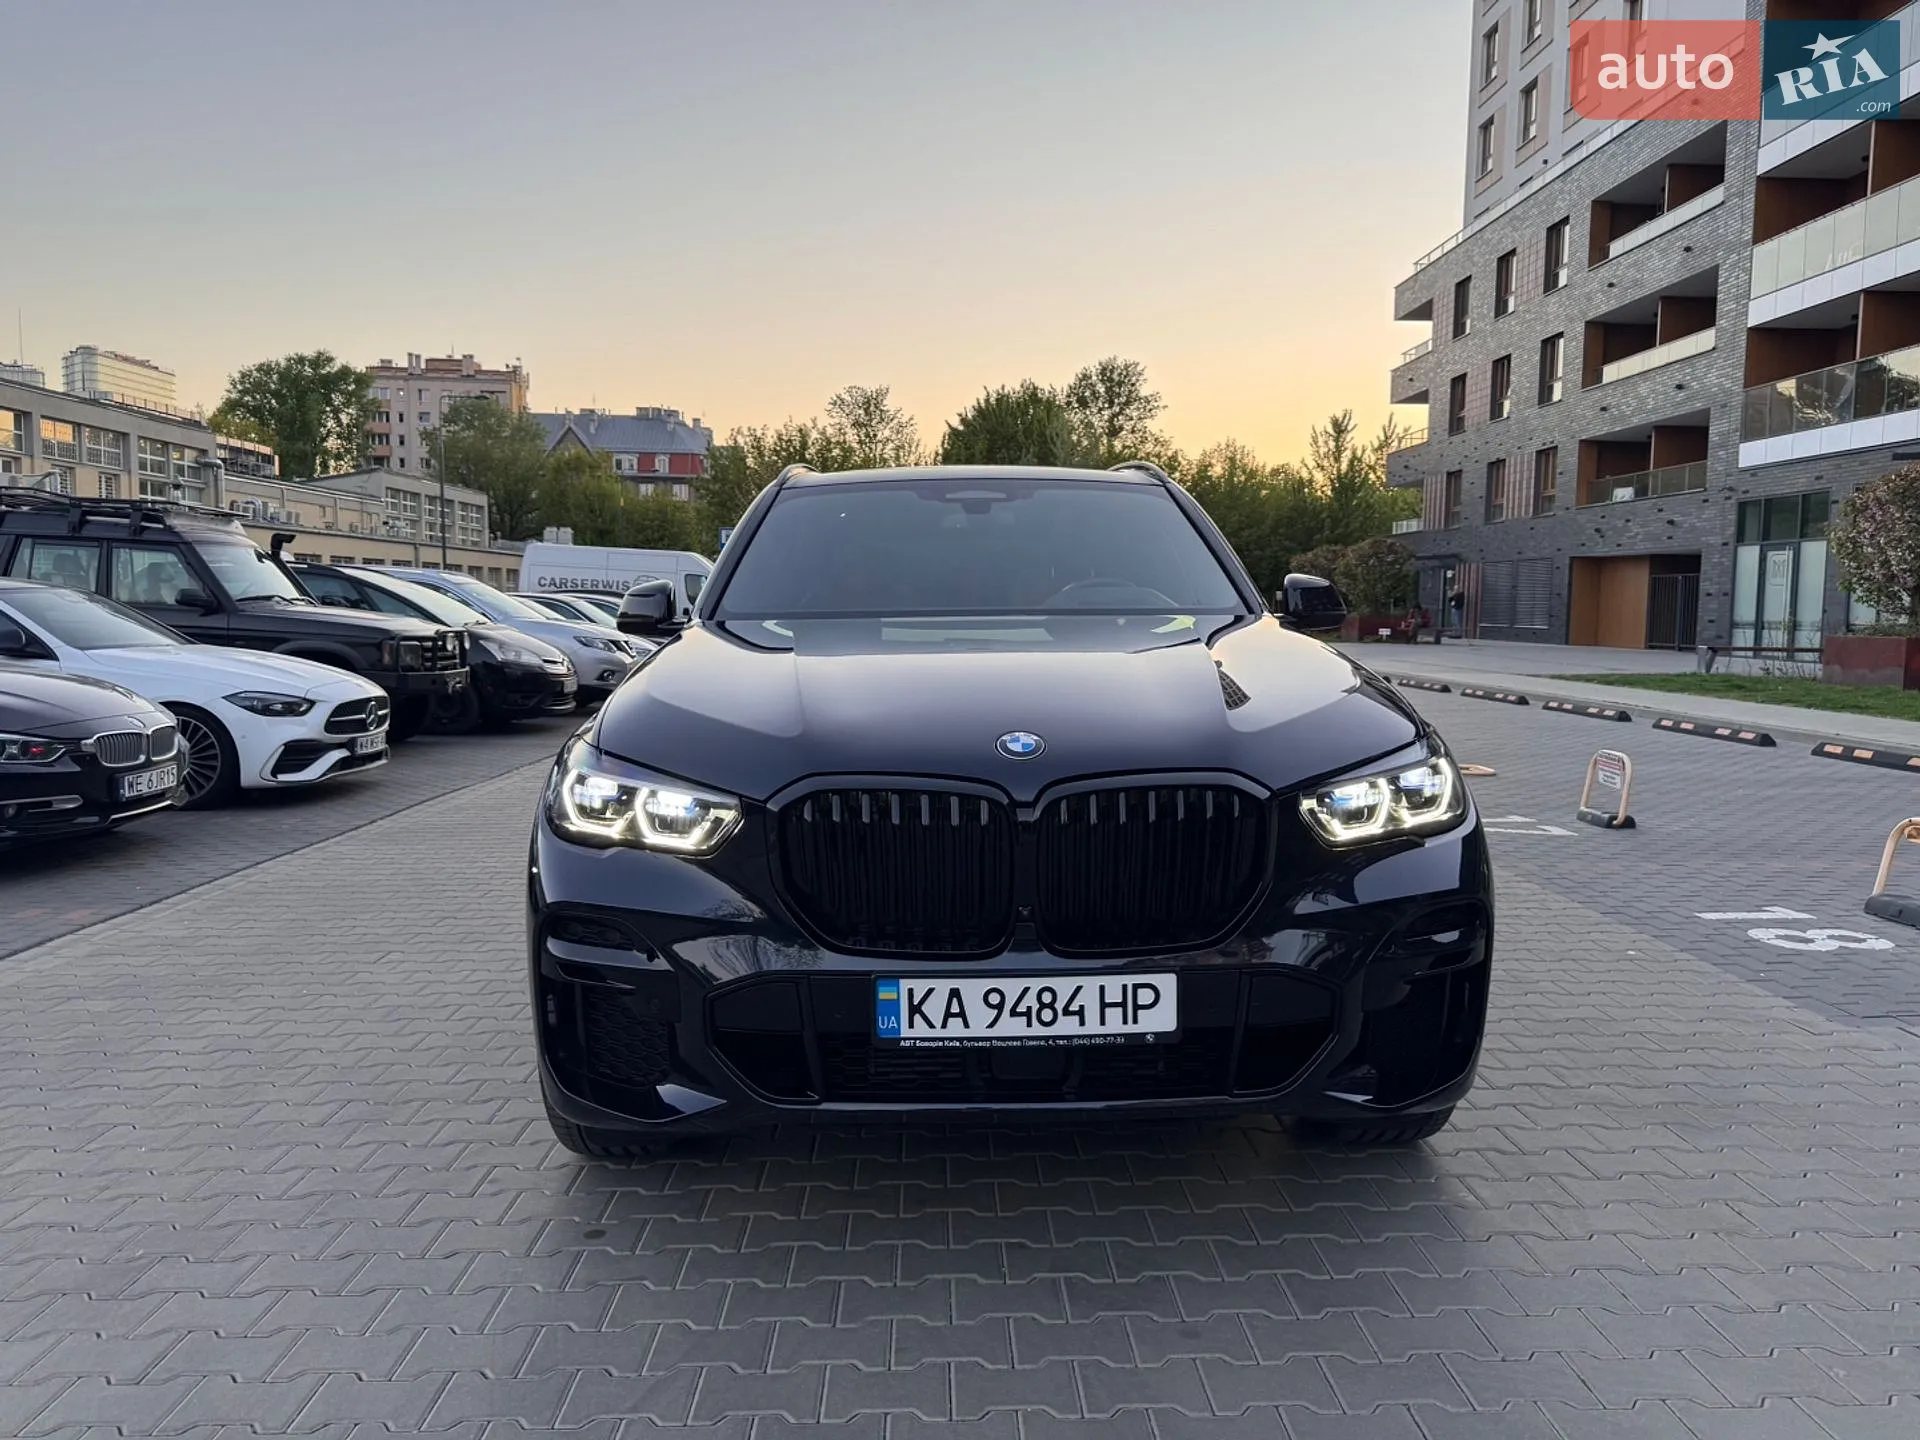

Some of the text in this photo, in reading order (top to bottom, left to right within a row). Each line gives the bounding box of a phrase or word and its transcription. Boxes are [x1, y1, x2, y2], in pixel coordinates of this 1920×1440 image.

[537, 576, 631, 592] CARSERWIS
[126, 766, 177, 795] WE 6JR15
[907, 982, 1161, 1029] KA 9484 HP
[878, 1016, 898, 1029] UA
